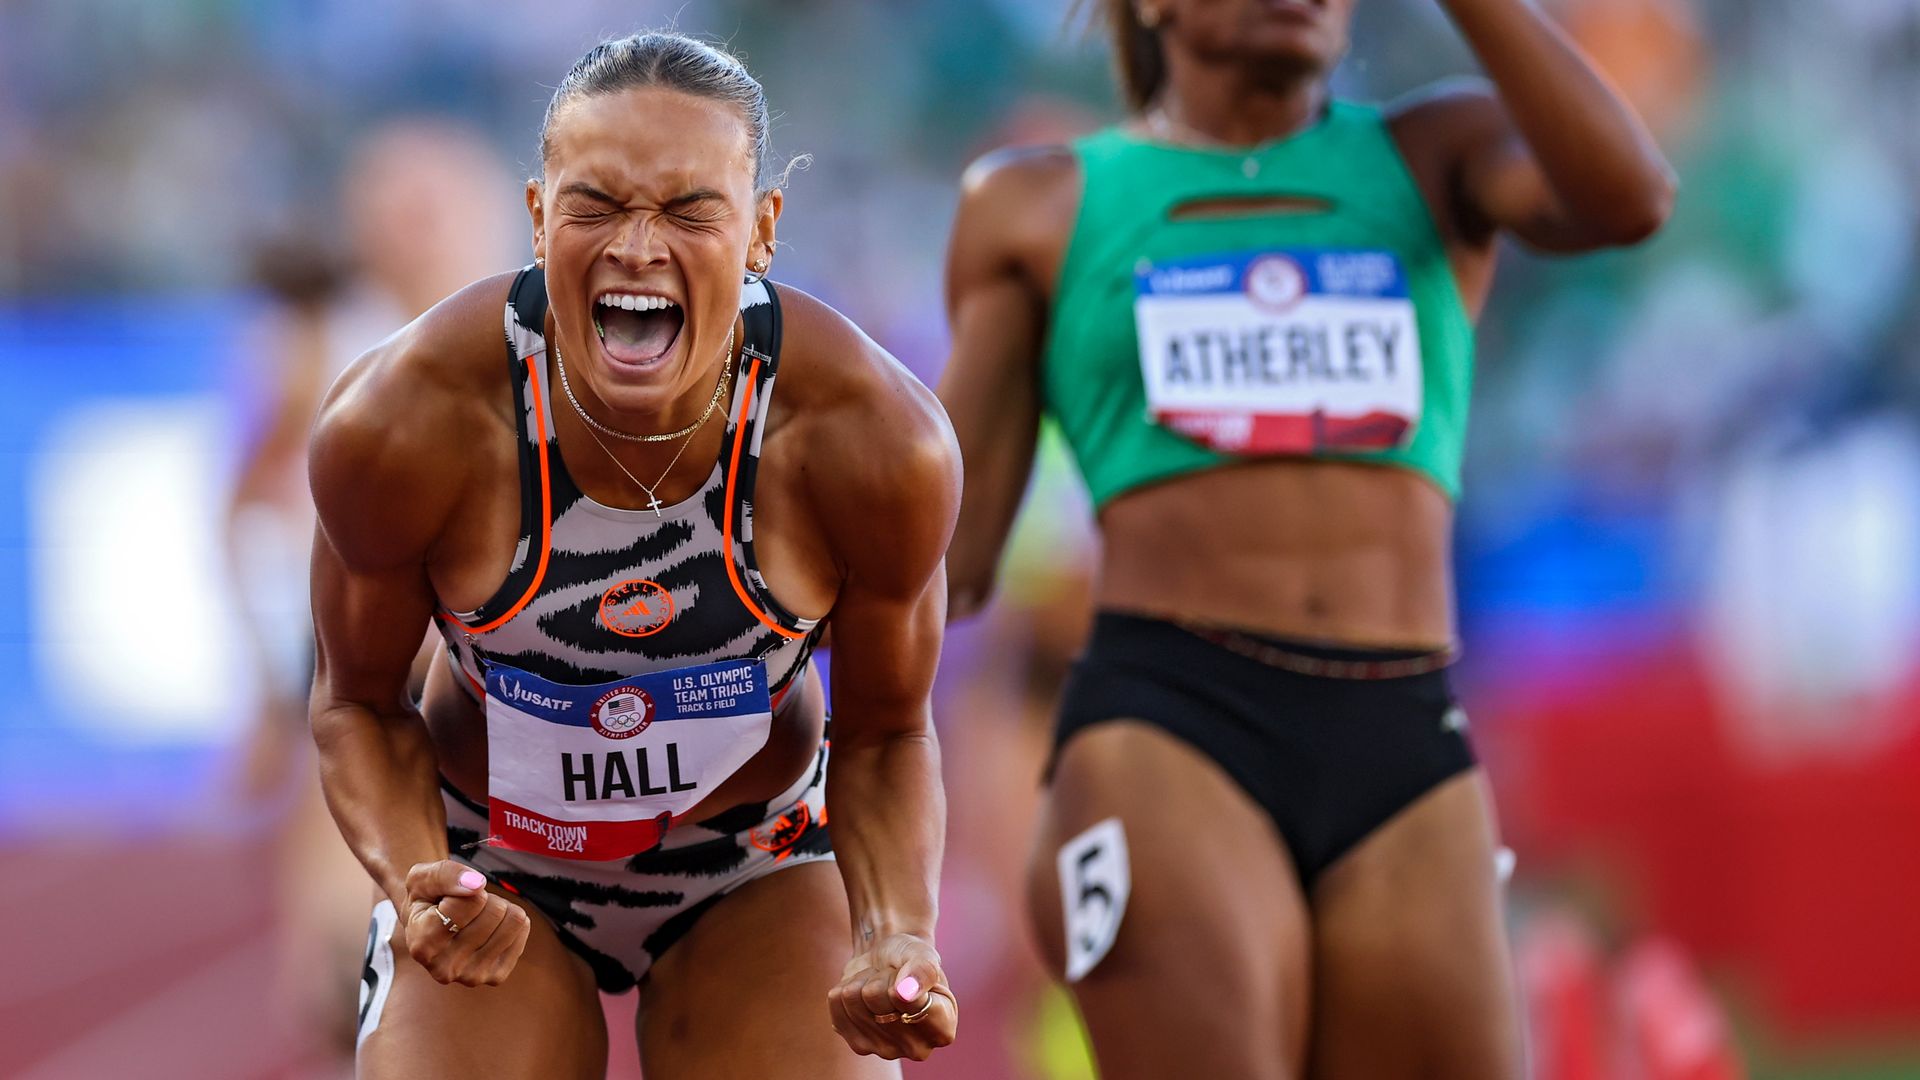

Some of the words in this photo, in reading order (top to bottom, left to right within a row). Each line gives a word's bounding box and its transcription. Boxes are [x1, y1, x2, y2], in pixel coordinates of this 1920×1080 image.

[1165, 321, 1400, 384] ATHERLEY
[673, 676, 698, 691] U.S.
[700, 666, 753, 687] OLYMPIC
[520, 689, 573, 711] USATF
[595, 688, 619, 707] UNITED
[621, 687, 647, 698] STATES
[674, 688, 708, 704] TEAM
[711, 680, 754, 699] TRIALS
[676, 702, 704, 714] TRACK
[705, 701, 713, 711] &
[714, 698, 736, 710] FIELD
[598, 728, 629, 738] OLYMPIC
[631, 721, 649, 735] TEAM
[561, 742, 697, 801] HALL
[503, 810, 588, 841] TRACKTOWN
[547, 836, 584, 853] 2024
[1076, 846, 1114, 953] 5
